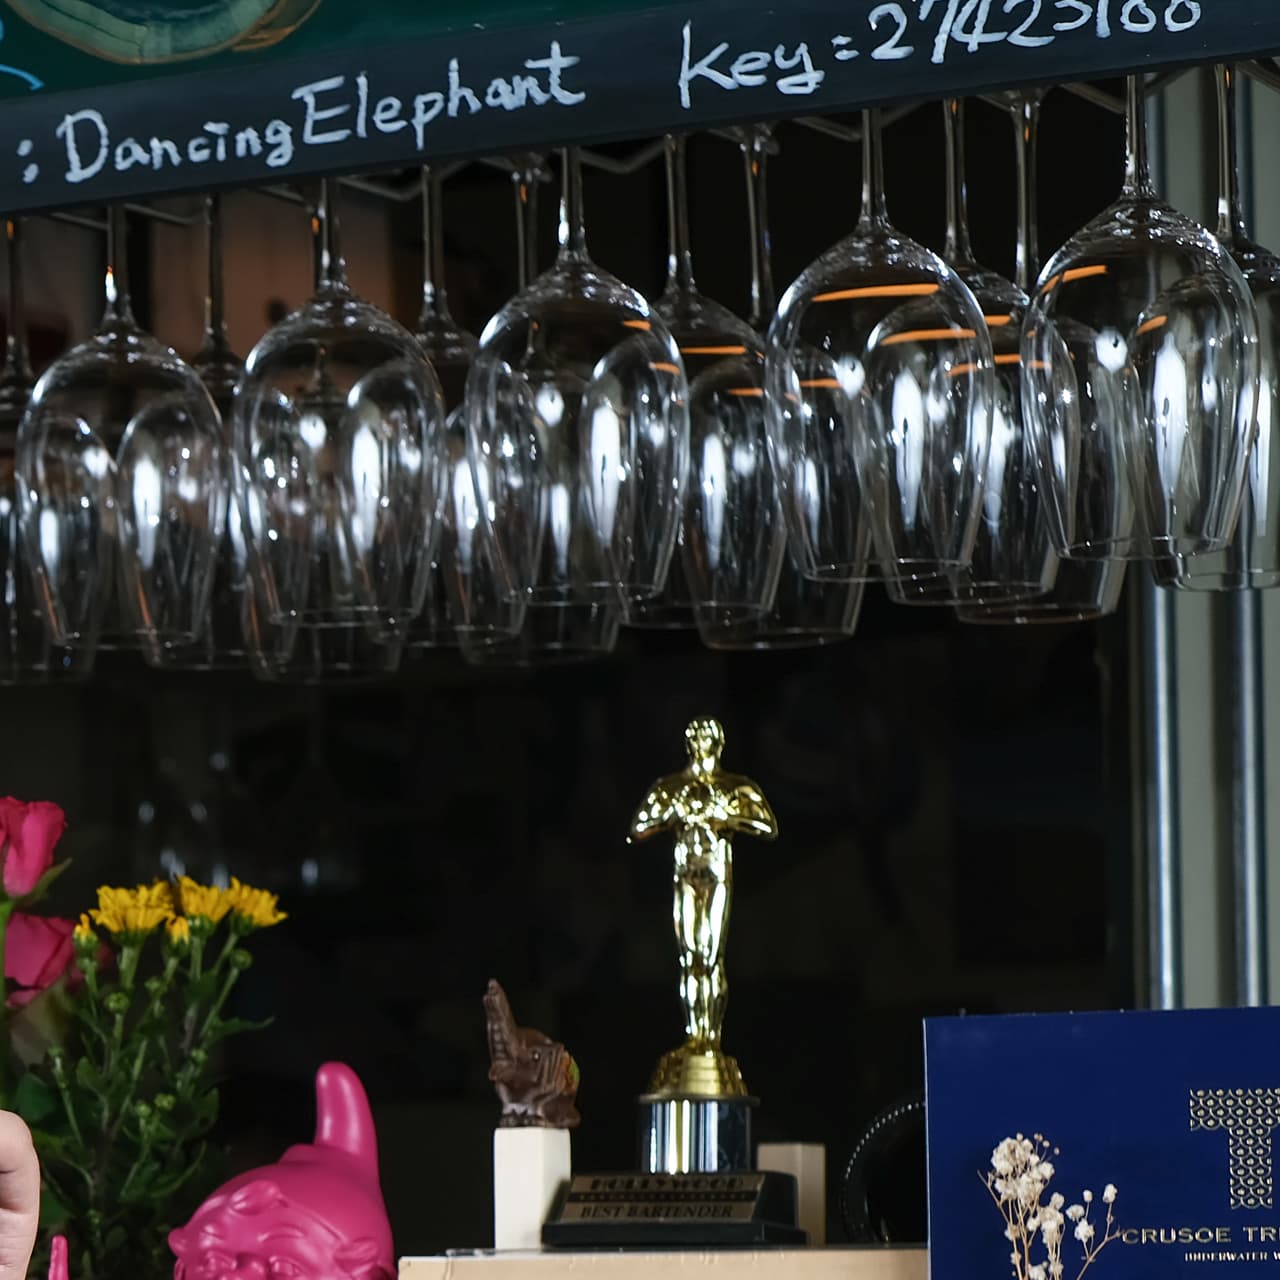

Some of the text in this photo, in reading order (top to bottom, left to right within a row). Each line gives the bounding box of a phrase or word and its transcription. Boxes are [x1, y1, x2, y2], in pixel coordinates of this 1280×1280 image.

[580, 1204, 734, 1218] BEST BARTENDER
[1122, 1227, 1232, 1245] CRUSOE
[1185, 1251, 1268, 1262] UNDERWATER
